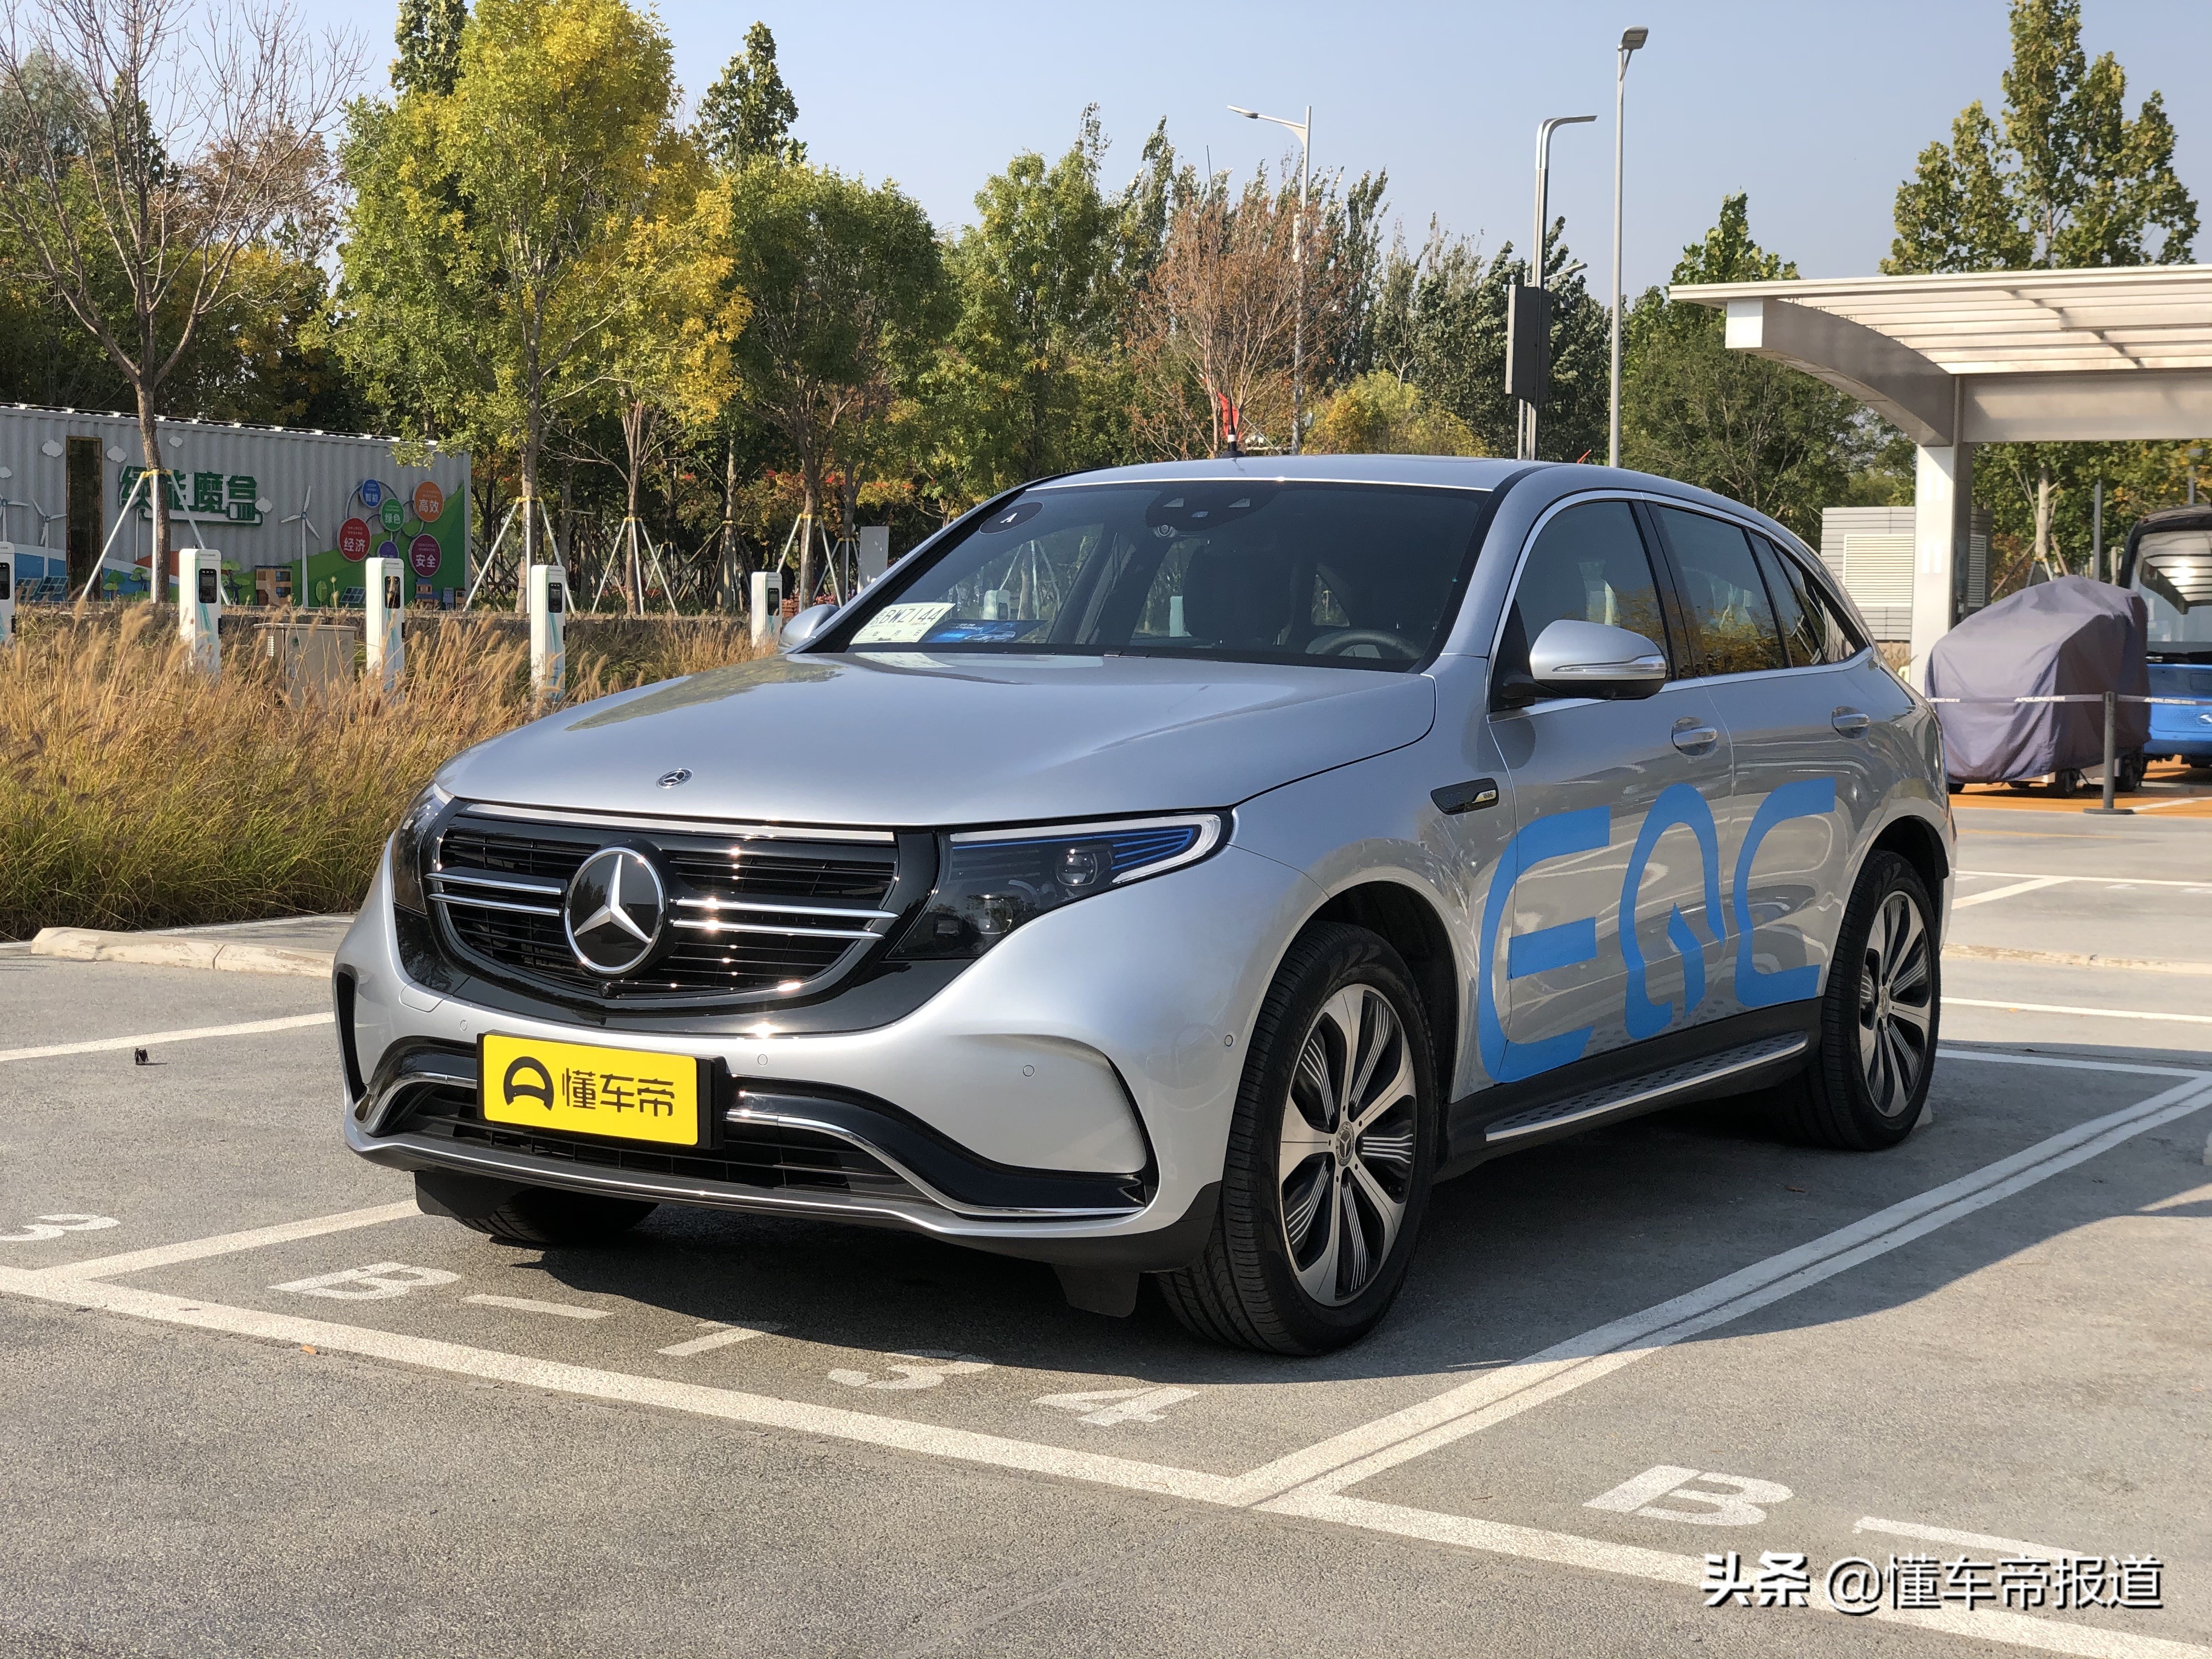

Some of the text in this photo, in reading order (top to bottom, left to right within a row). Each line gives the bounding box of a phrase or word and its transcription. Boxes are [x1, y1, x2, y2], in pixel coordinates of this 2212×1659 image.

[418, 499, 439, 514] 高效
[385, 514, 401, 524] 绿色
[344, 537, 365, 552] 经济
[415, 554, 436, 568] 安全
[1478, 777, 1836, 1084] EQC
[562, 1067, 675, 1117] 懂车帝
